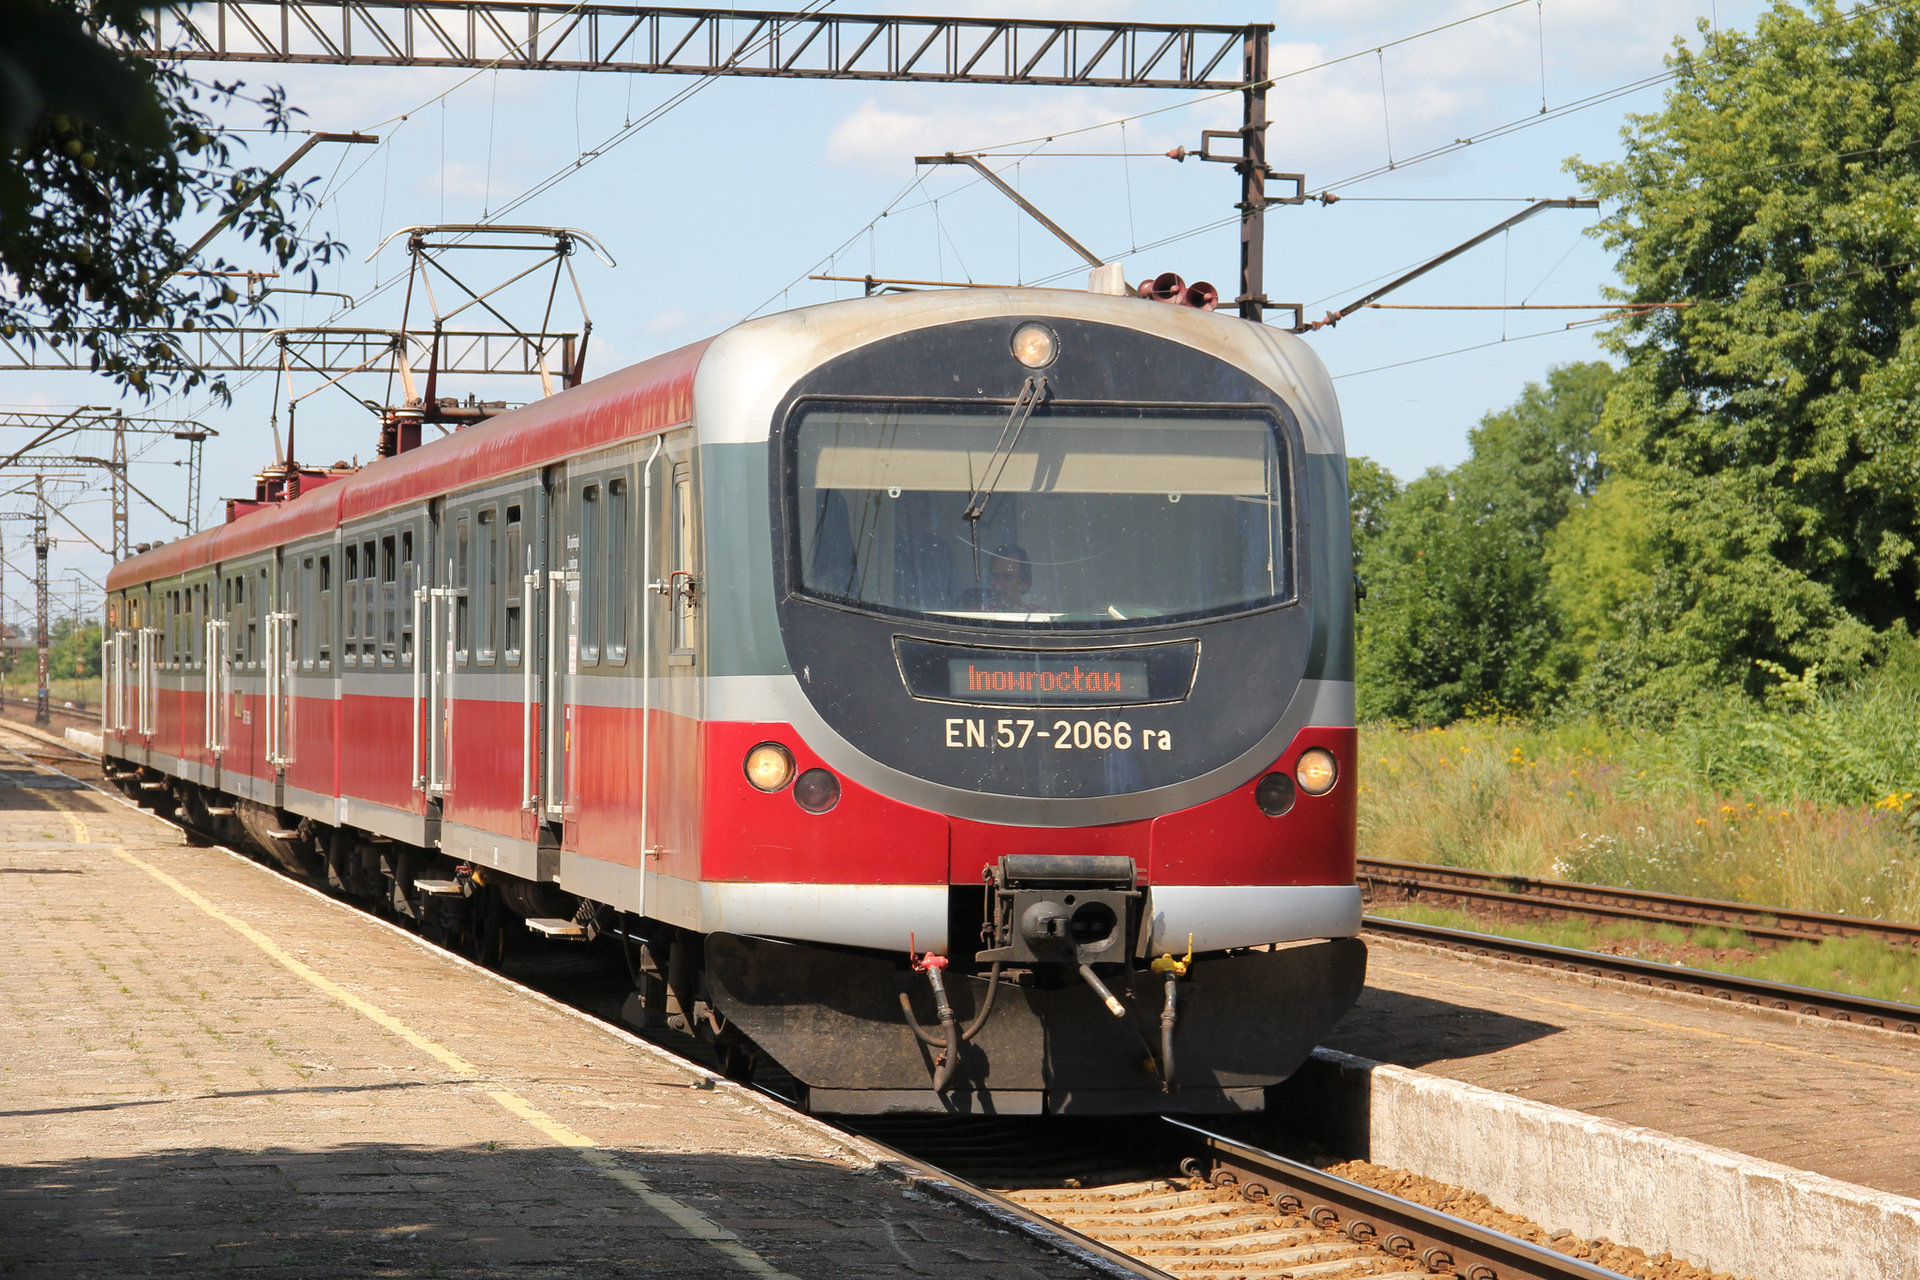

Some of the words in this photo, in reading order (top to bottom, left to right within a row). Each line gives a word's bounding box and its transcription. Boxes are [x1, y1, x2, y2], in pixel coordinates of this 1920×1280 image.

[968, 665, 1122, 692] Inowrocław
[945, 718, 985, 748] EN
[996, 719, 1133, 750] 57-2066
[1142, 729, 1172, 751] ra
